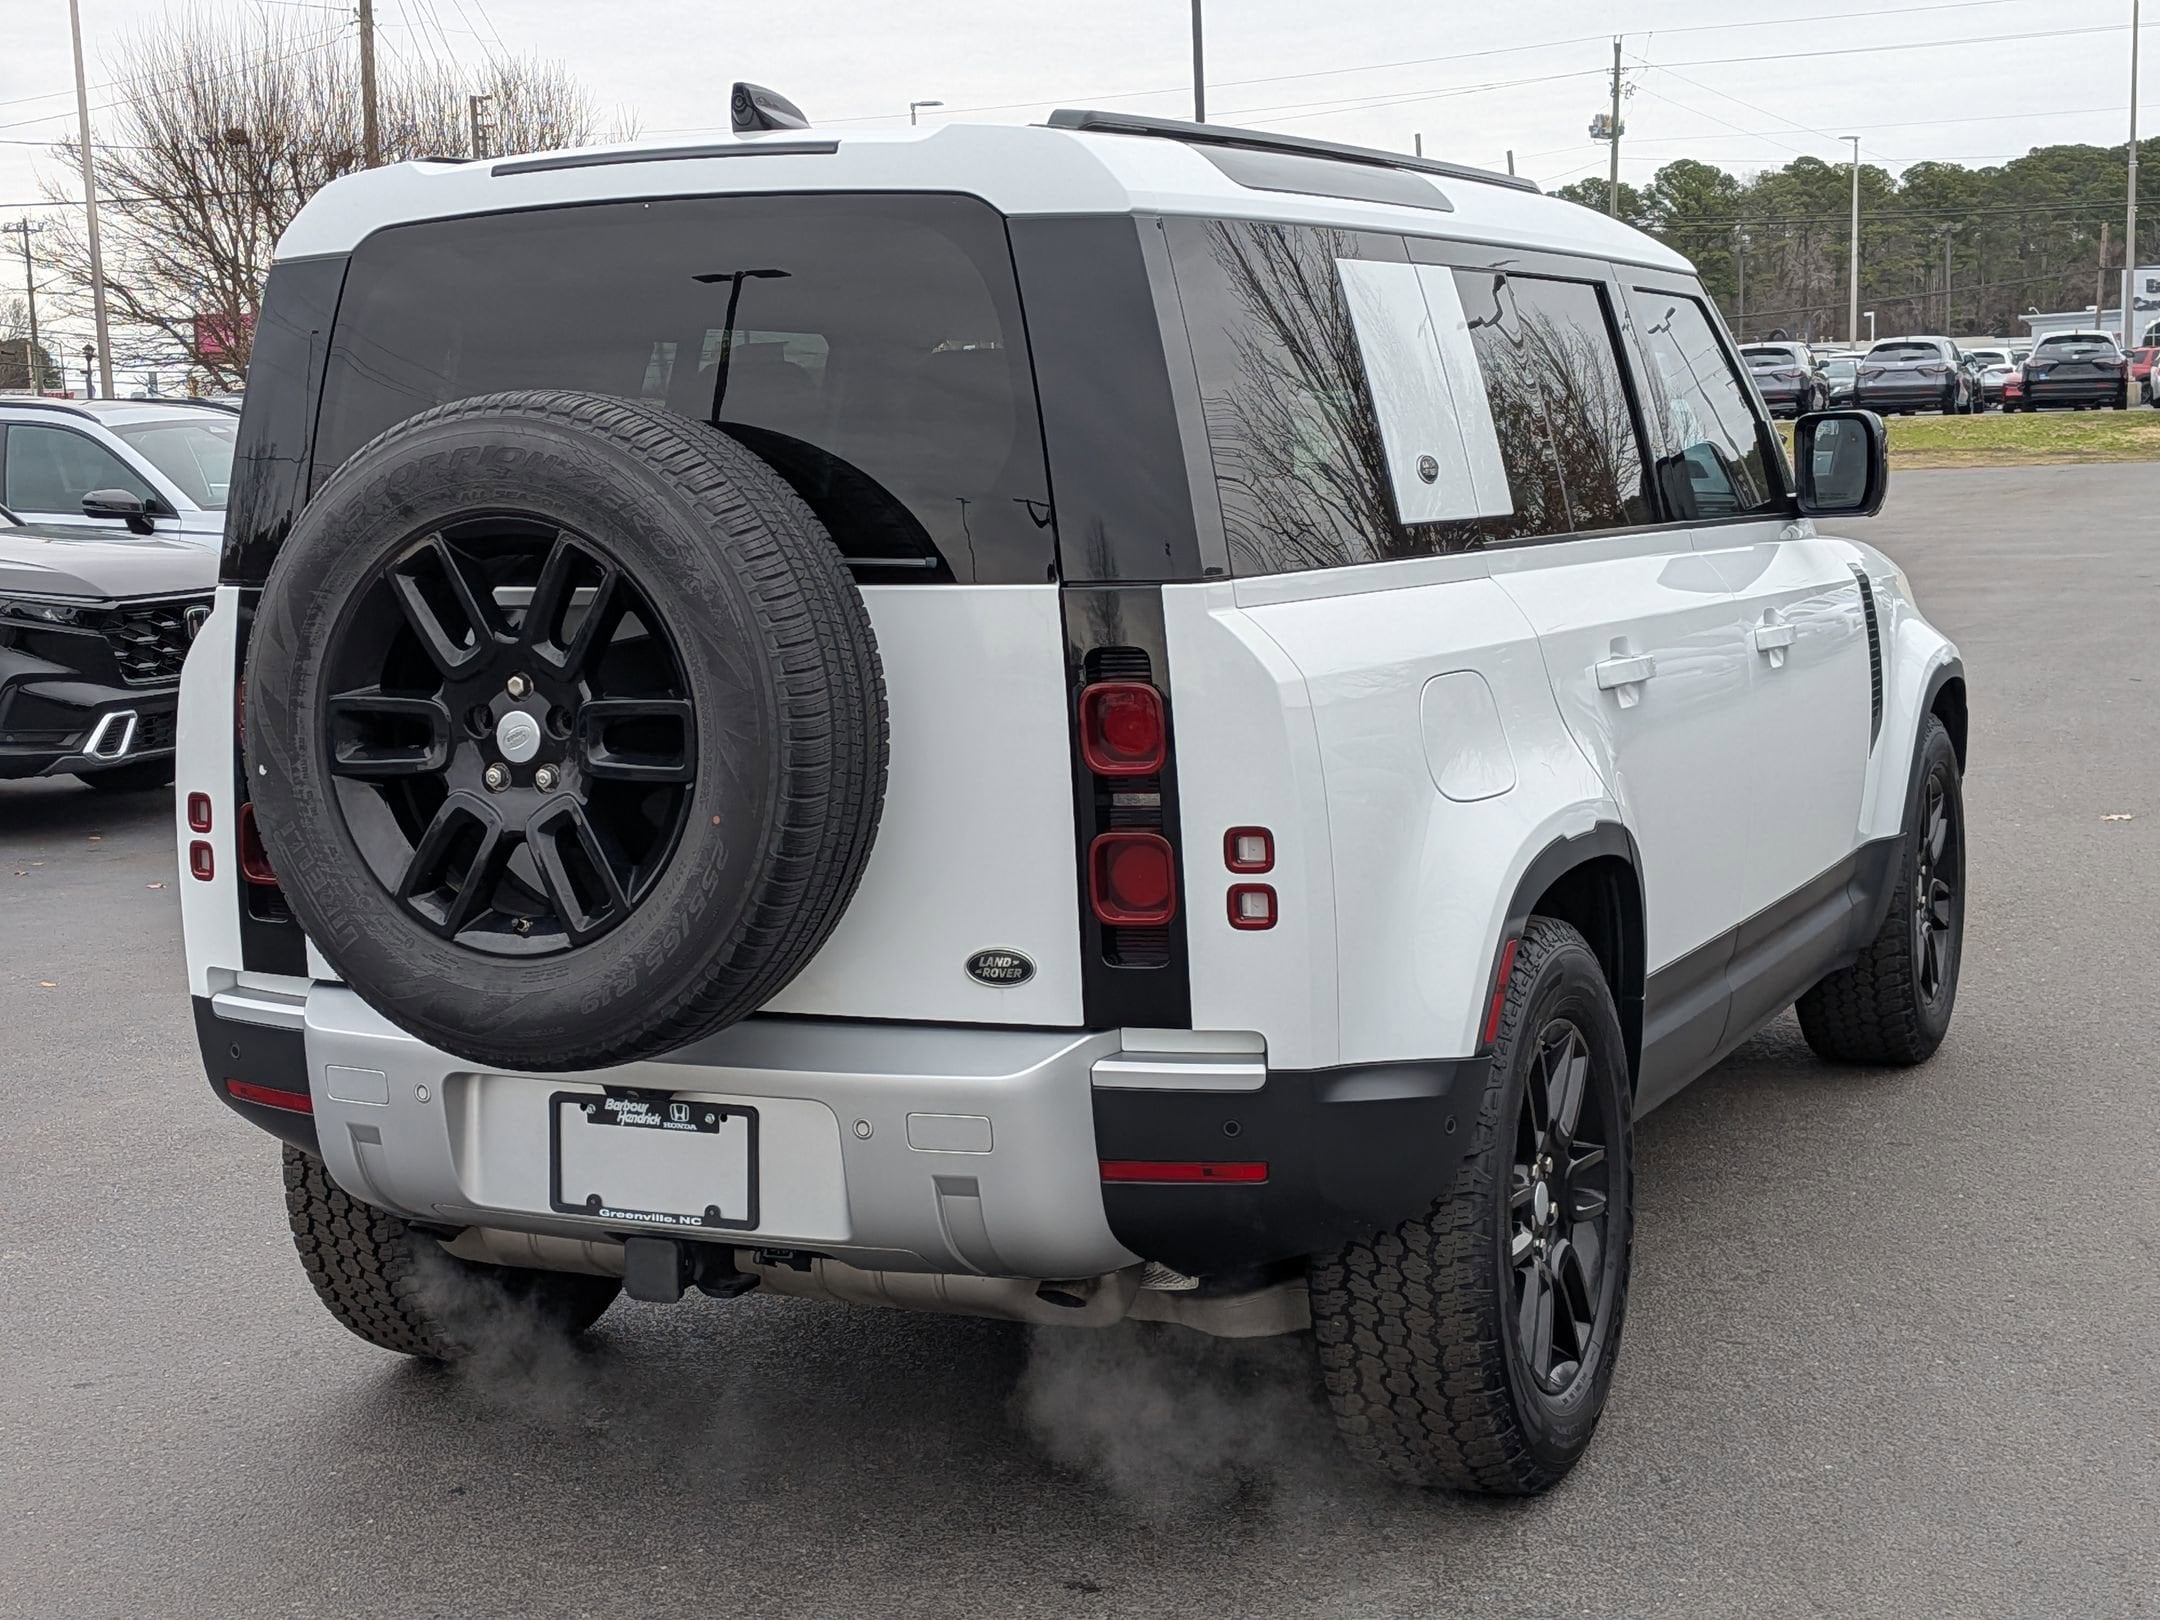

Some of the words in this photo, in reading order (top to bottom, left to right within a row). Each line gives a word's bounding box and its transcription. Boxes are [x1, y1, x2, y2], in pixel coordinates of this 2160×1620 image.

[336, 444, 563, 529] SCORPION
[270, 820, 361, 959] PIRELLI
[639, 838, 733, 976] 255/65
[979, 957, 1011, 967] LAND
[982, 968, 1022, 978] ROVER
[605, 1098, 649, 1113] Barbour
[617, 1112, 661, 1126] Hendrick
[663, 1121, 697, 1131] HONDA
[679, 1216, 702, 1226] NC
